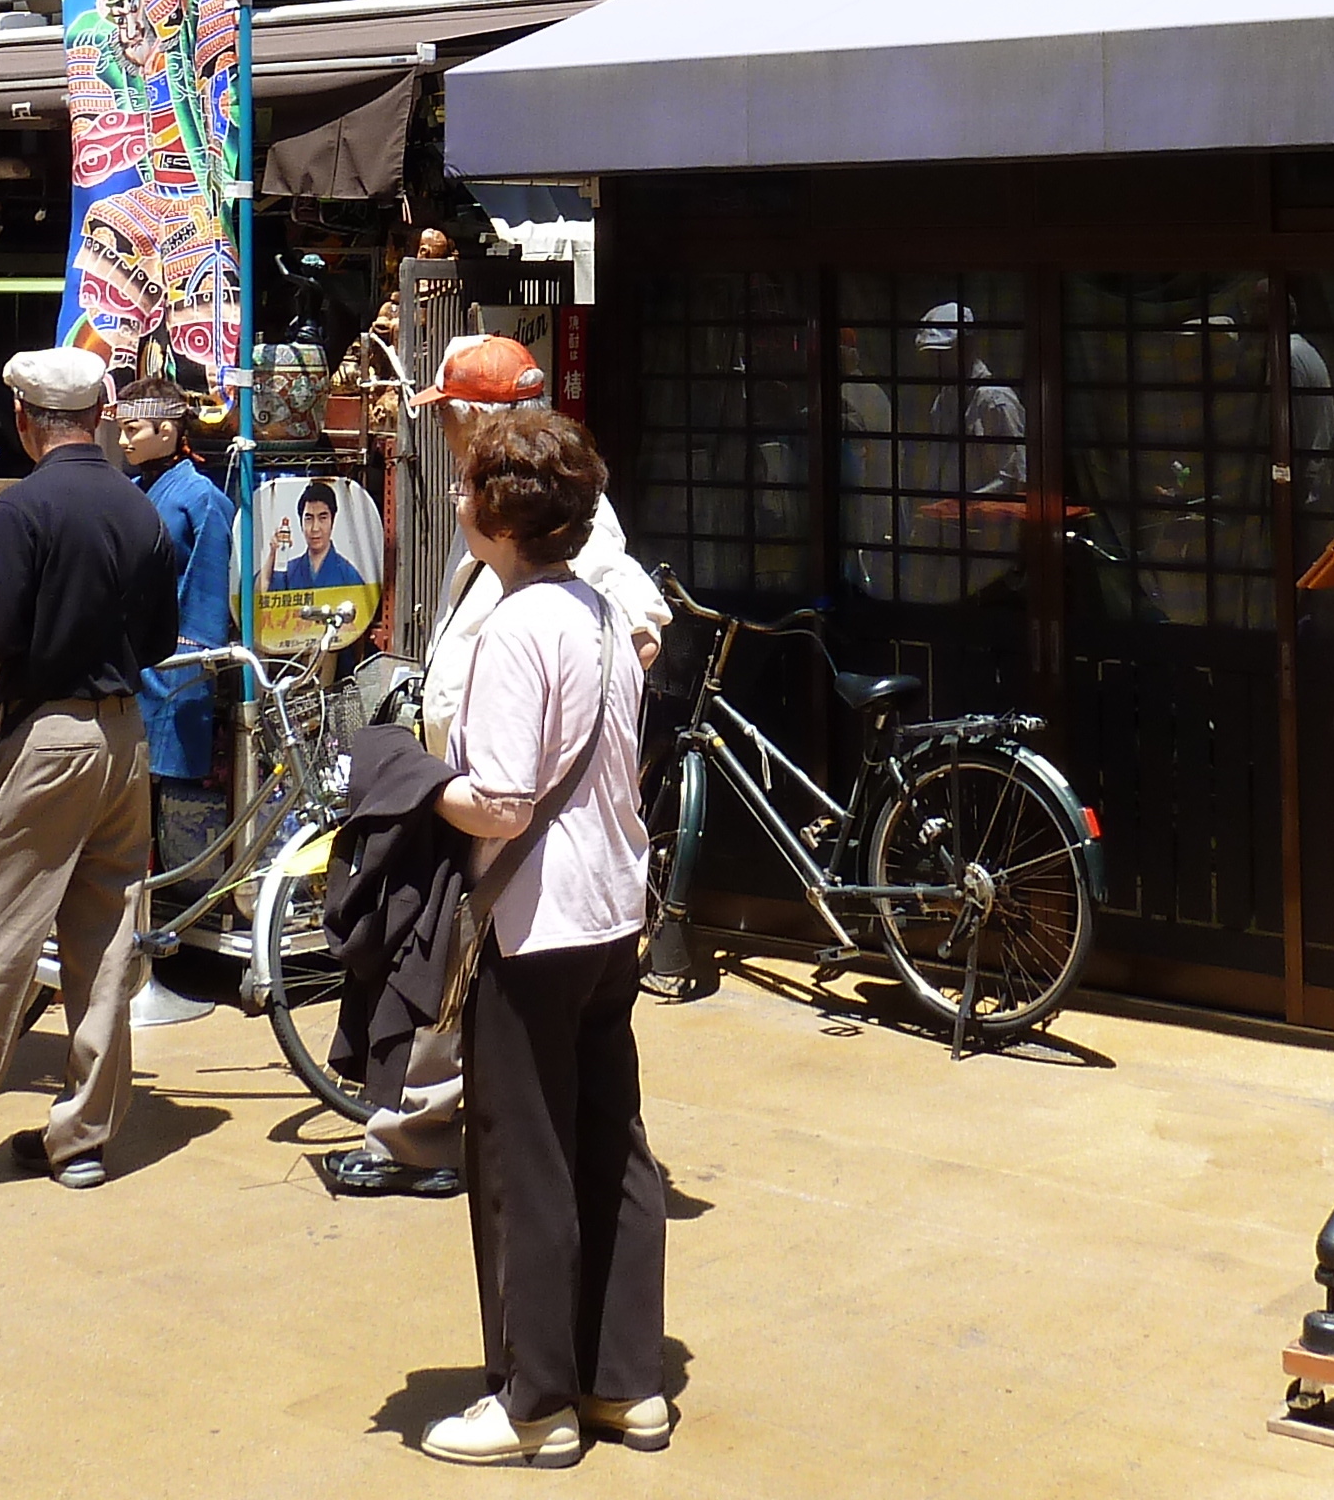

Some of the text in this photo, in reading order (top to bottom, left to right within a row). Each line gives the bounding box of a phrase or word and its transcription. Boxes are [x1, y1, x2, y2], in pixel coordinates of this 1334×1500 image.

[258, 592, 315, 610] 強力殺虫剤
